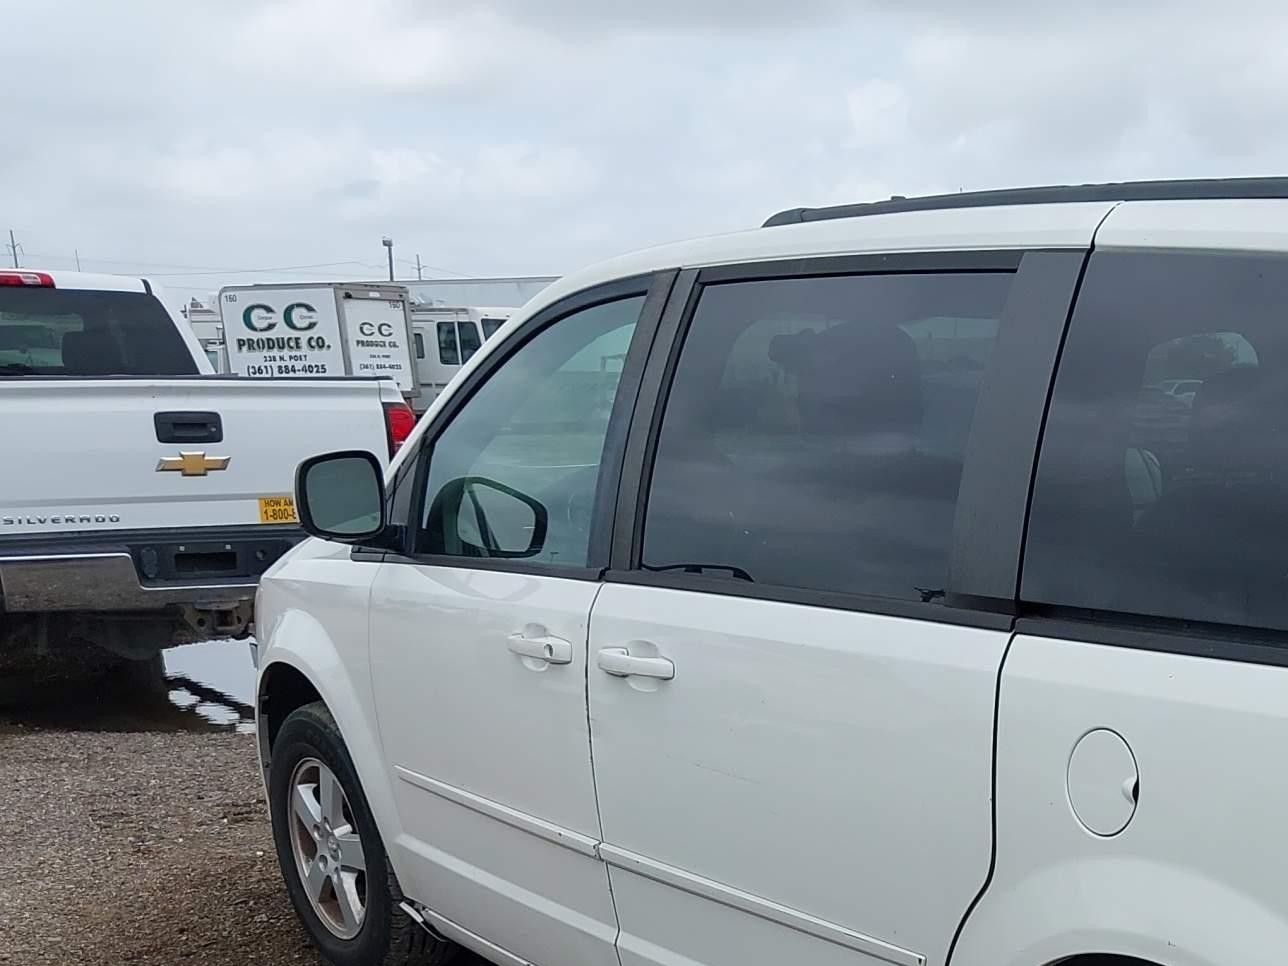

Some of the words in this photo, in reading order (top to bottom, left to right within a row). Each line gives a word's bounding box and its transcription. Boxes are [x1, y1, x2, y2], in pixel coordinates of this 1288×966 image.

[237, 337, 302, 352] PRODUCE
[307, 336, 332, 350] CO.
[247, 365, 274, 377] (361)
[277, 364, 328, 375] 884-4025
[264, 499, 281, 507] HOW
[2, 514, 120, 526] SILVERADO
